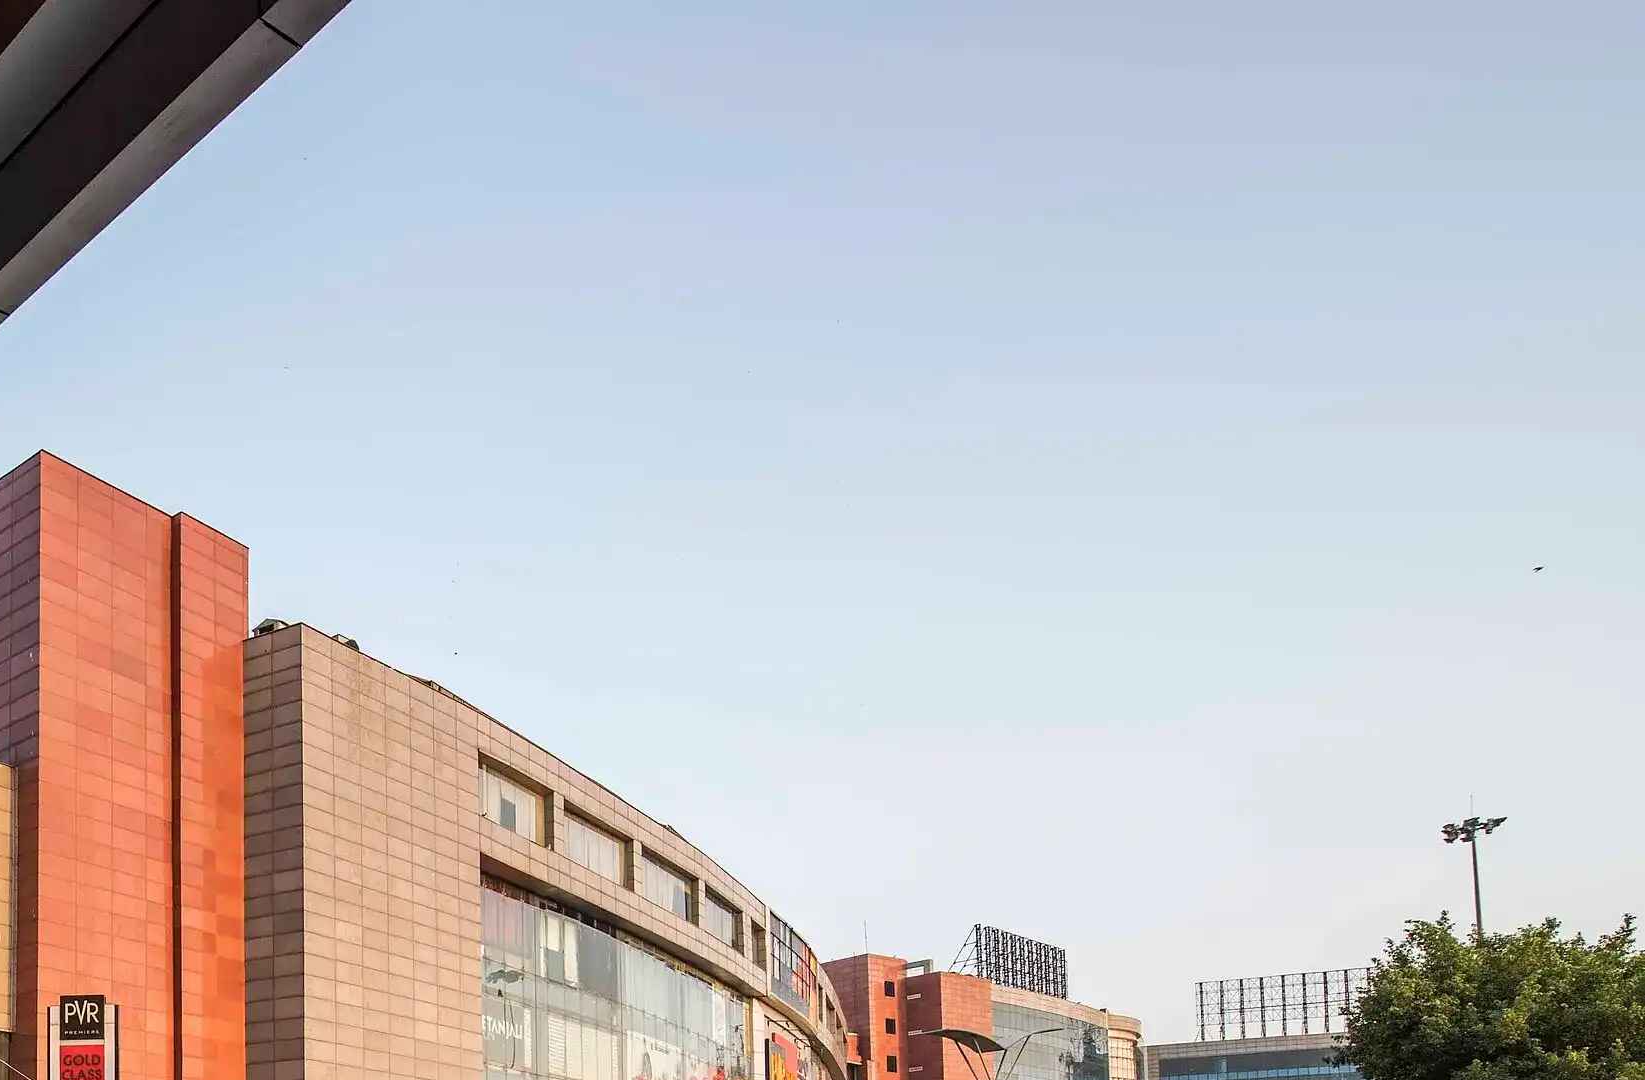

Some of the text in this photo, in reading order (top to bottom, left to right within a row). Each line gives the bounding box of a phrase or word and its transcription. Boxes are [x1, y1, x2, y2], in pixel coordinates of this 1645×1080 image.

[65, 1000, 99, 1025] PVR
[63, 1054, 101, 1067] GOLD
[62, 1068, 103, 1080] CLASS
